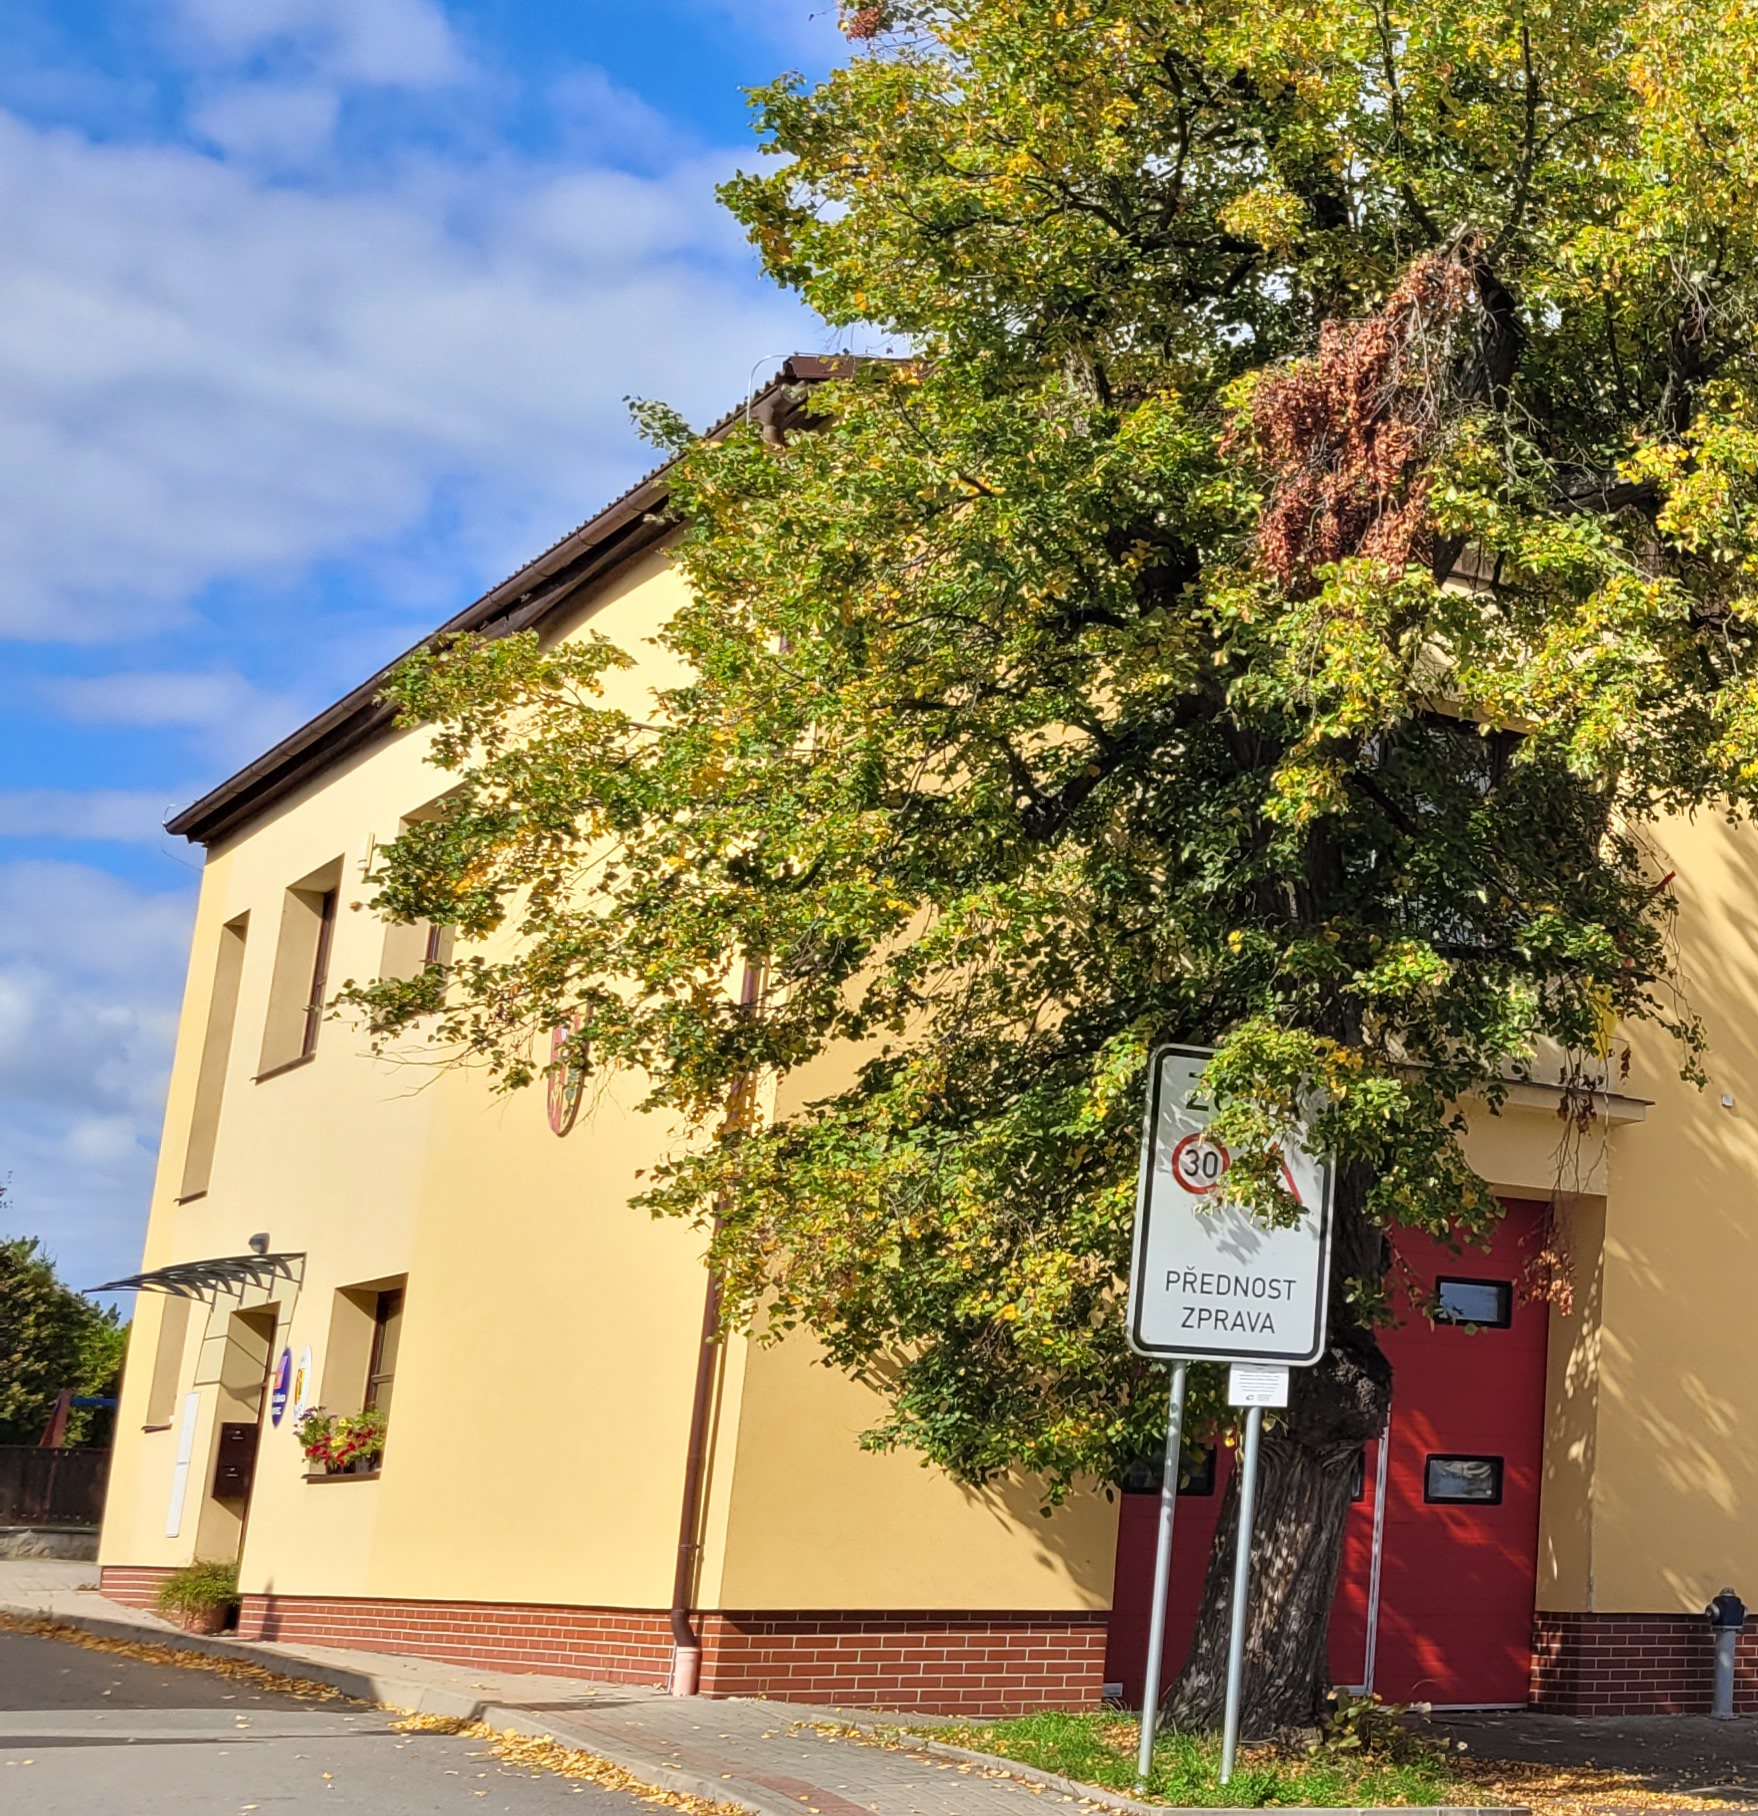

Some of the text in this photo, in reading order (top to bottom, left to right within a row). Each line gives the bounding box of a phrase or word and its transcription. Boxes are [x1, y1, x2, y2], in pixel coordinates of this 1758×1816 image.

[1184, 1149, 1218, 1179] 30
[1165, 1265, 1297, 1301] PŘEDNOST
[1181, 1306, 1275, 1334] ZPRAVA
